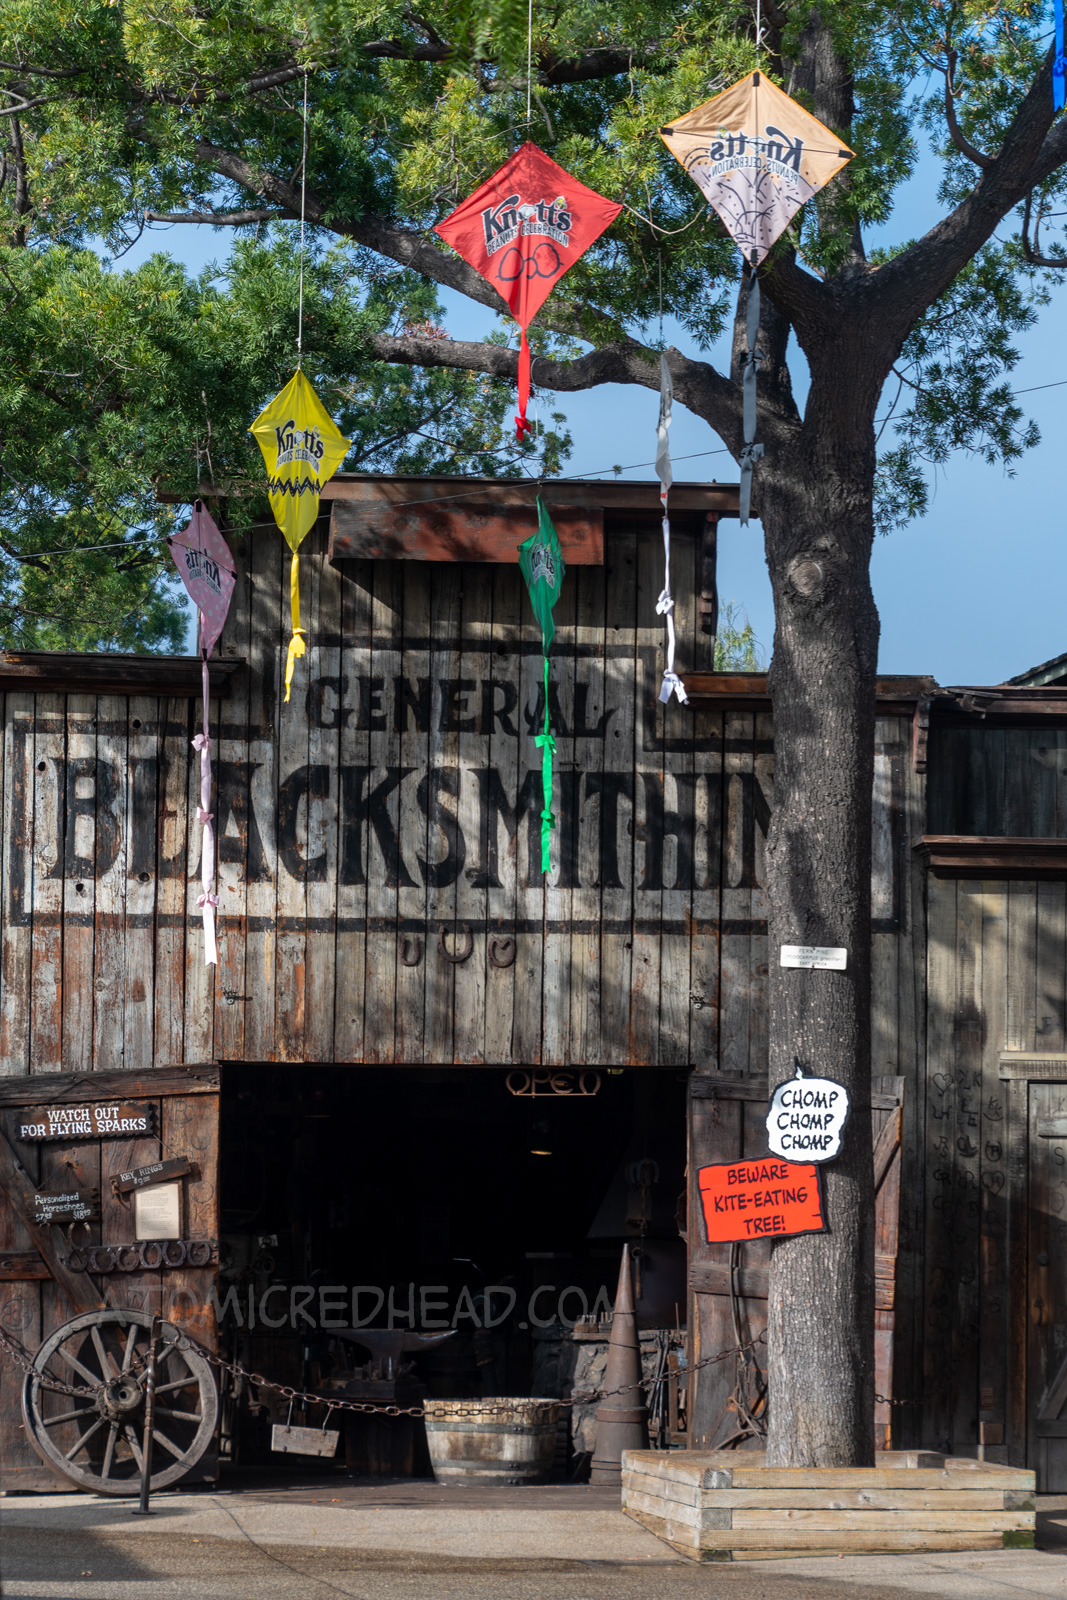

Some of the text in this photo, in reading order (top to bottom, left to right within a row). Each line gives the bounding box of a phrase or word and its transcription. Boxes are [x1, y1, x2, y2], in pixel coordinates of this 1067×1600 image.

[487, 222, 570, 257] PEANUTS CELEBRATION
[307, 675, 615, 738] GENERAL
[43, 756, 775, 890] BLACKSMITHIN
[505, 1069, 602, 1096] OPEN
[780, 1089, 839, 1109] CHOMP
[47, 1106, 120, 1123] WATCH OUT
[777, 1112, 835, 1131] CHOMP
[20, 1117, 147, 1138] FOR FLYING SPARKS
[780, 1133, 834, 1151] CHOMP
[120, 1163, 164, 1182] KEY RINGS
[727, 1163, 790, 1186] BEWARE
[34, 1192, 80, 1206] Personalized
[714, 1186, 808, 1213] KITE-EATING
[742, 1214, 786, 1236] TREE!
